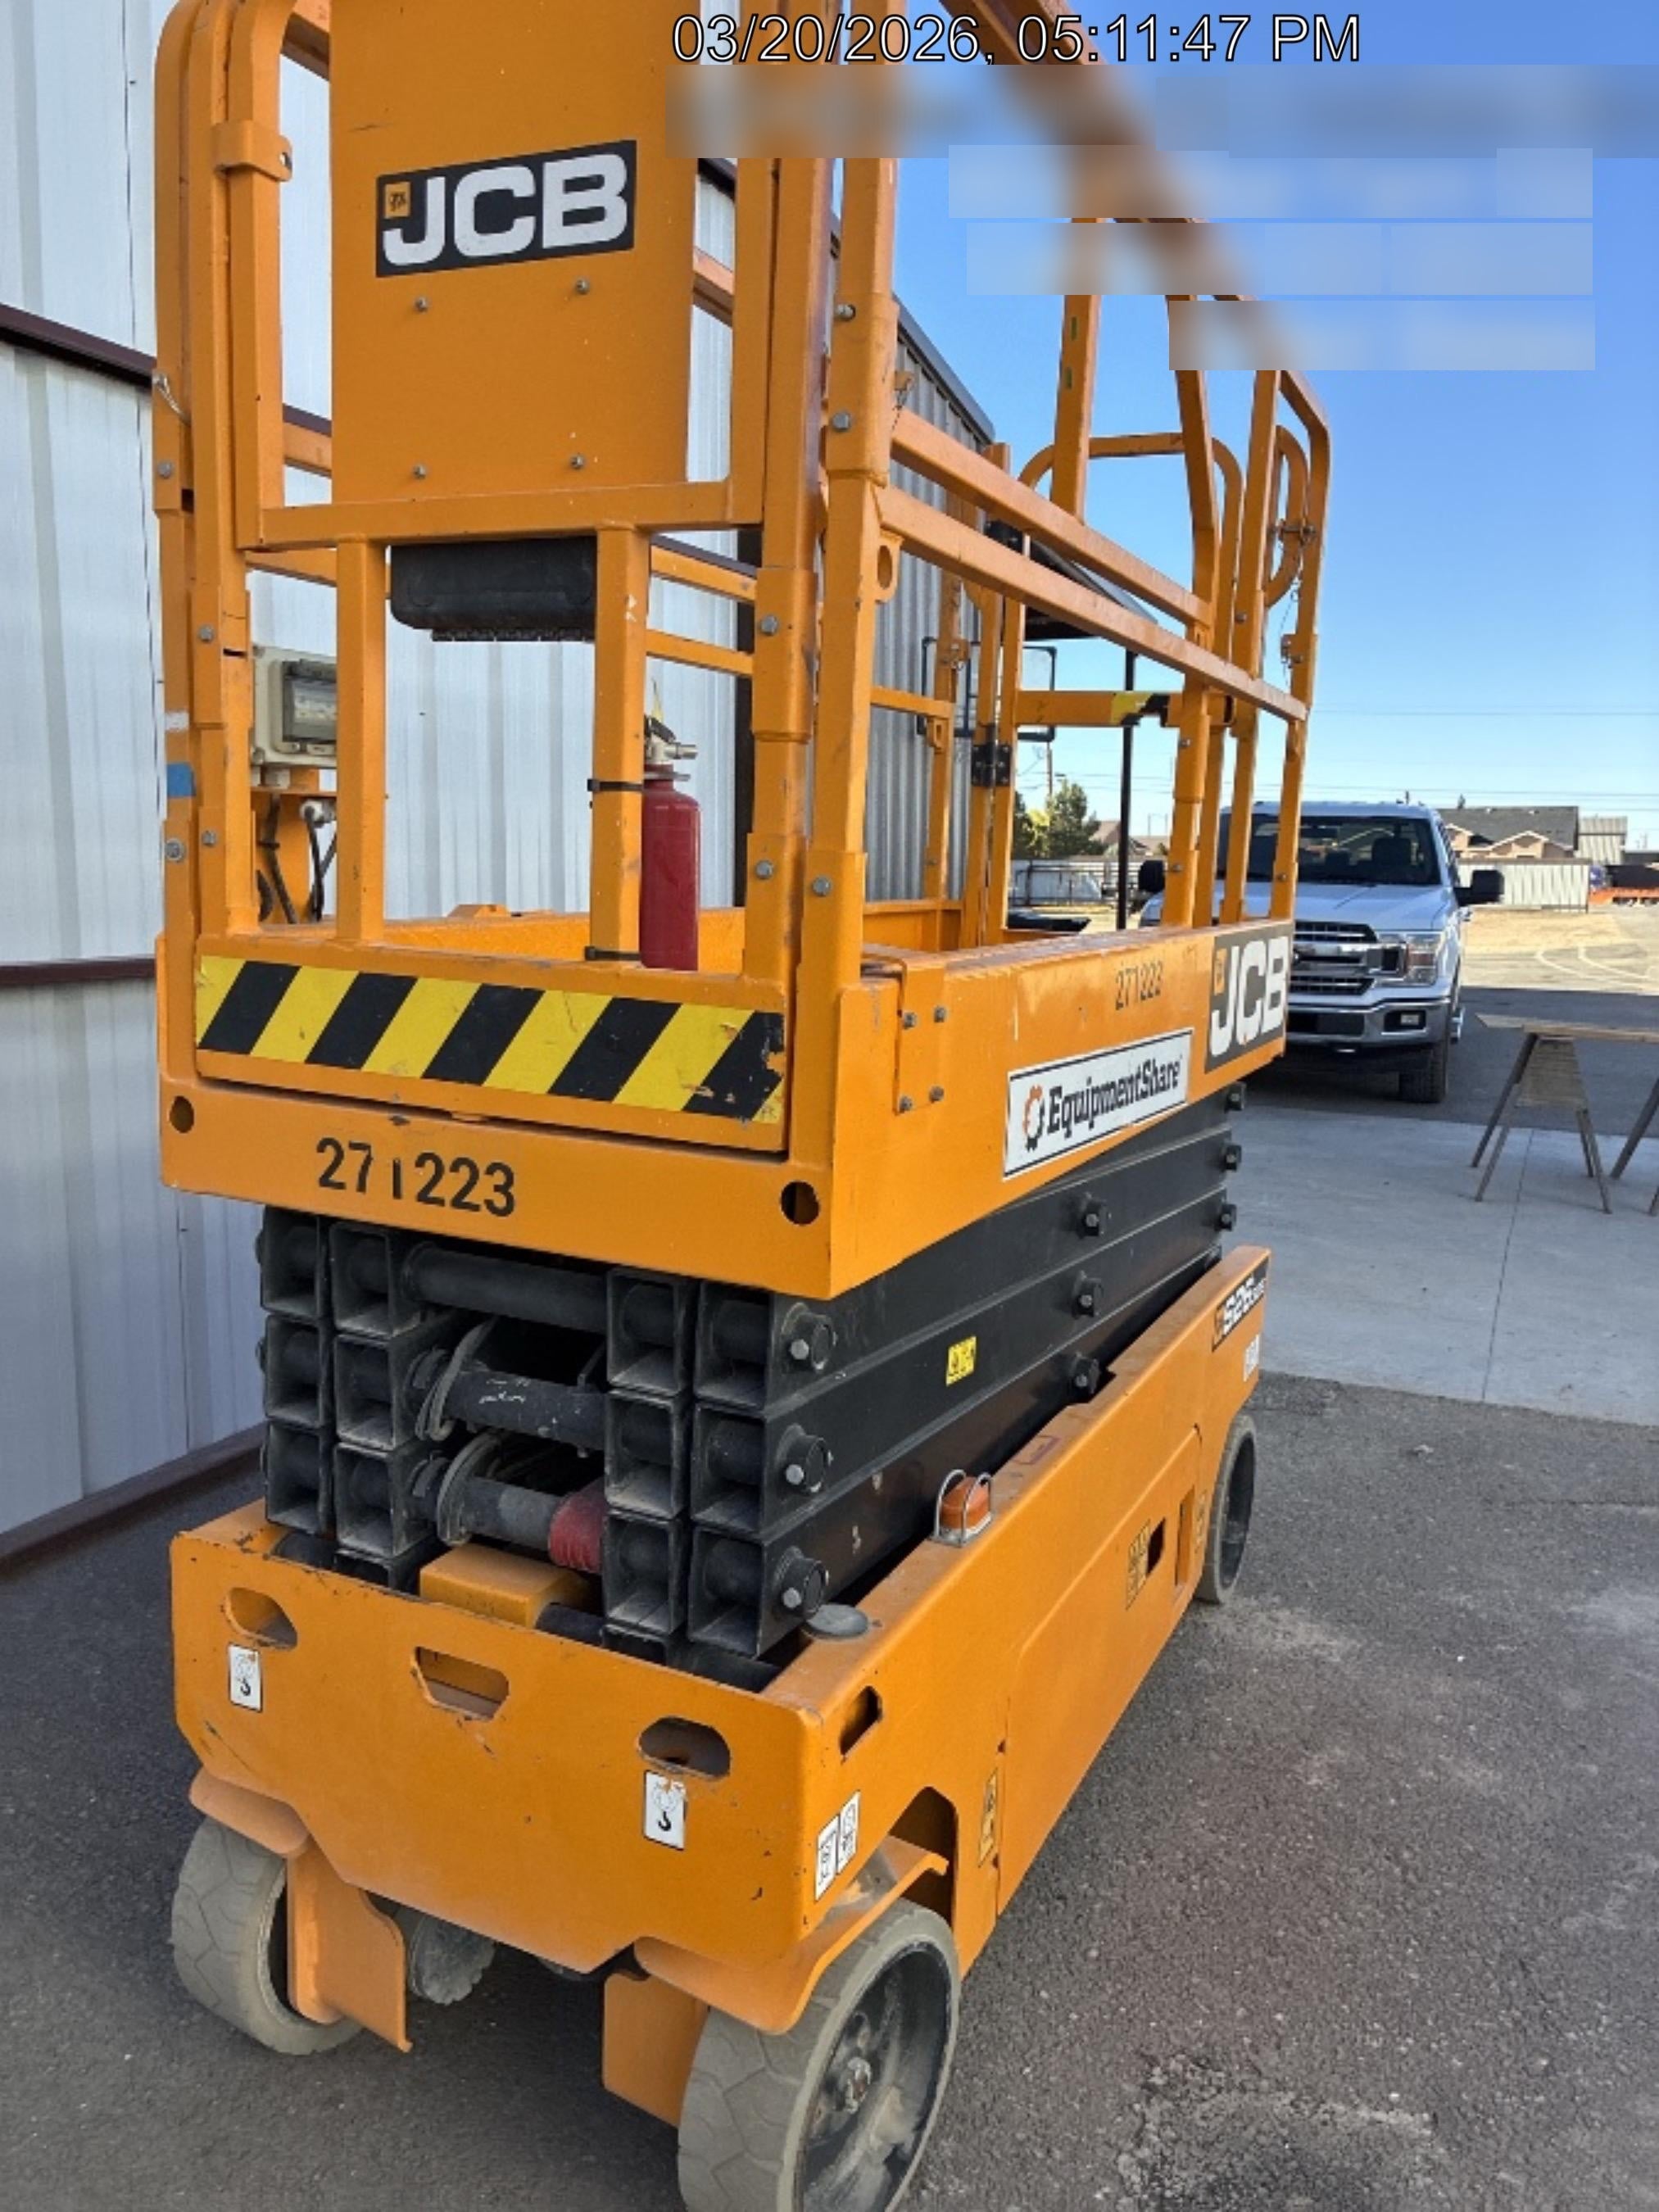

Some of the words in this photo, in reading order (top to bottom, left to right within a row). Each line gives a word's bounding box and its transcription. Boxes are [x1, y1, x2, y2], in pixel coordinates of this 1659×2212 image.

[382, 153, 628, 266] JCB
[1210, 936, 1290, 1058] JCB
[1047, 1058, 1181, 1139] EquipmentShare
[316, 1136, 515, 1217] 271223
